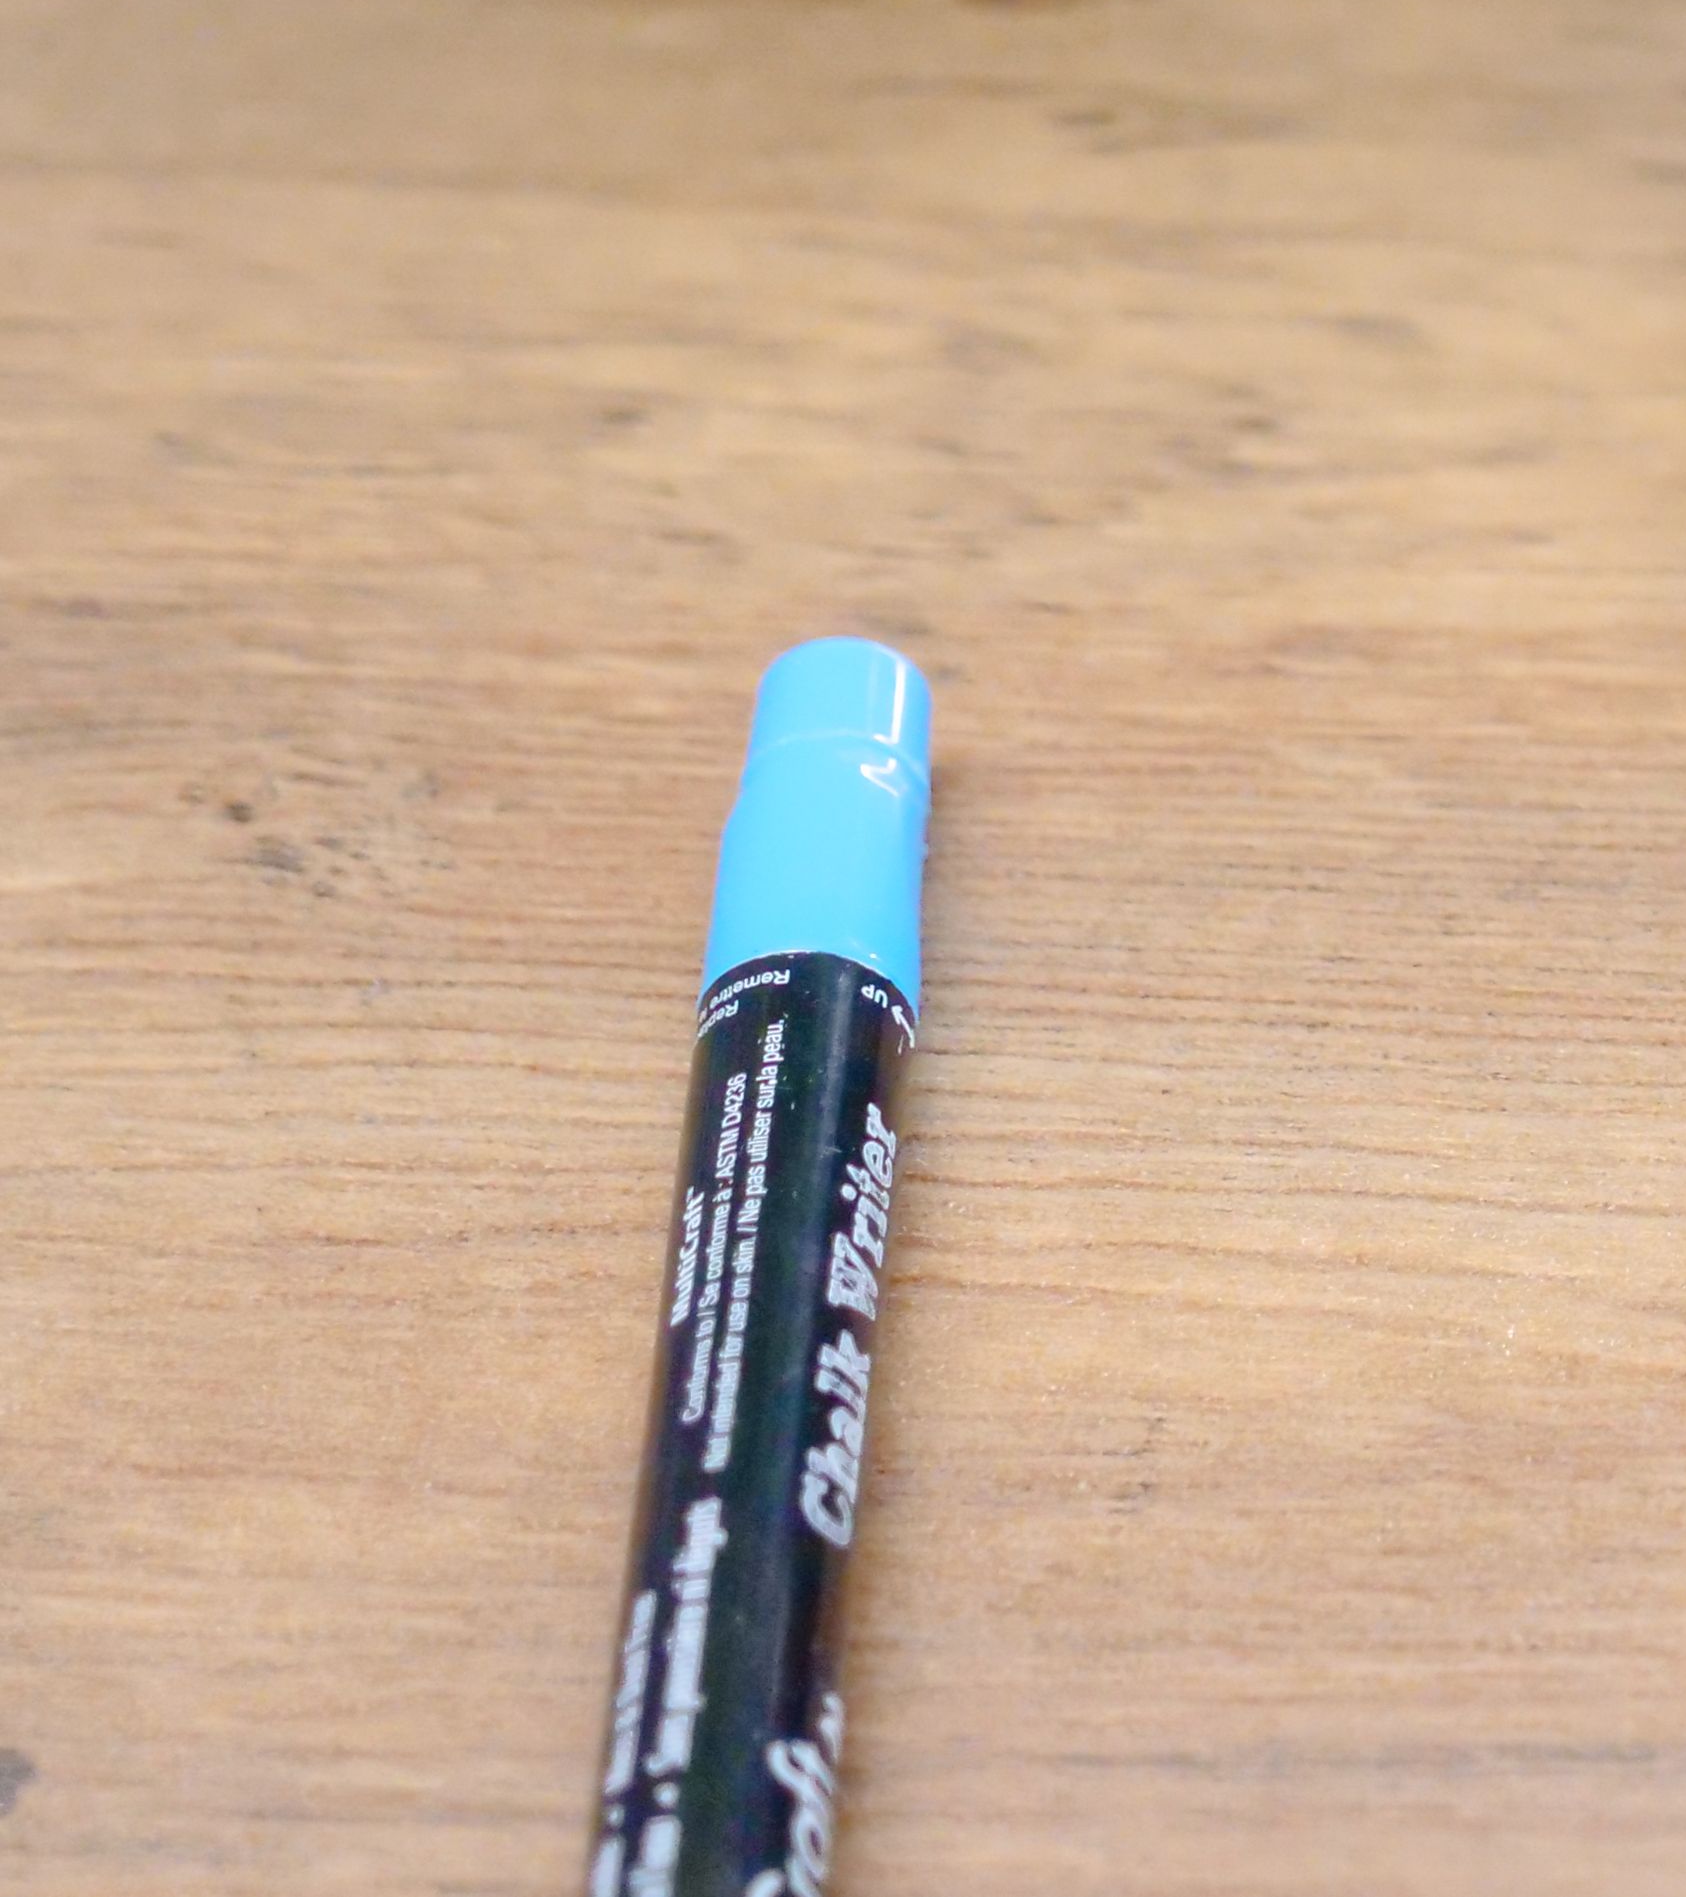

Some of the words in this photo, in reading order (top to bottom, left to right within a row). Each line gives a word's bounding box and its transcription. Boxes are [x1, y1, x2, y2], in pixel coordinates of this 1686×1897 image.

[709, 969, 790, 1009] Remettre
[860, 984, 888, 1009] UP
[756, 1066, 777, 1083] la
[722, 1073, 746, 1127] D4236
[715, 1128, 739, 1178] ASTM
[747, 1111, 771, 1162] utiliser
[712, 1188, 732, 1202] à
[745, 1165, 767, 1196] pas
[738, 1199, 761, 1223] Ne
[829, 1103, 897, 1320] Writer
[707, 1203, 730, 1280] conforme
[699, 1282, 720, 1308] Se
[732, 1277, 750, 1298] on
[696, 1318, 715, 1338] to
[728, 1300, 747, 1331] use
[719, 1334, 742, 1360] for
[682, 1339, 713, 1422] Conforms
[711, 1360, 740, 1434] intended
[703, 1436, 730, 1471] Not
[800, 1330, 870, 1547] Chalk
